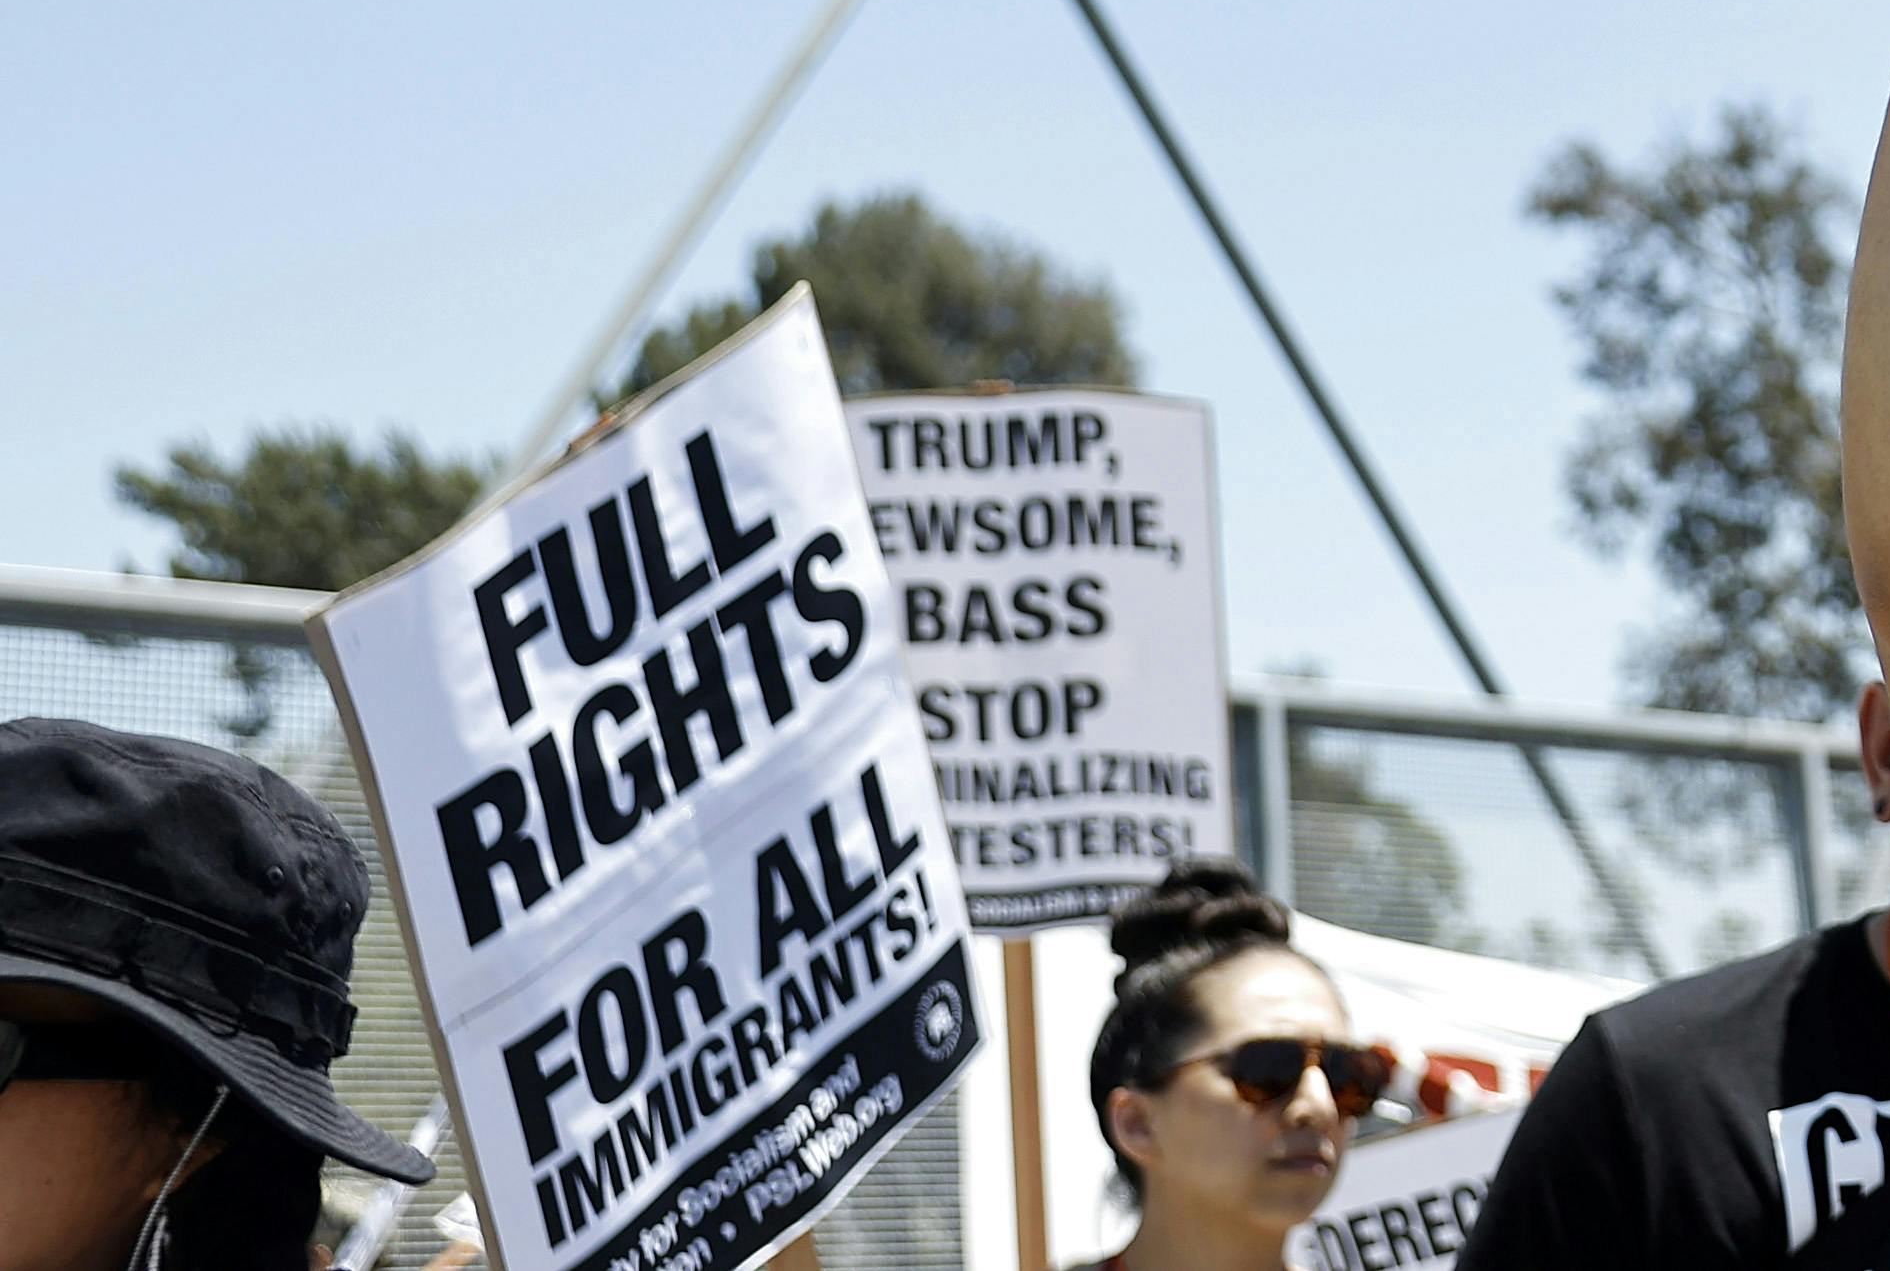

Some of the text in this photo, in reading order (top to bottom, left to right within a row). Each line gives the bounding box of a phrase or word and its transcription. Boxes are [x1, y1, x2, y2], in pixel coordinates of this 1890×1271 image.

[867, 411, 1120, 478] TRUMP,
[870, 494, 1183, 570] EWSOME,
[472, 429, 777, 728] FULL
[904, 575, 1108, 645] BASS
[436, 531, 865, 948] RIGHTS
[918, 678, 1103, 743] STOP
[935, 753, 1212, 803] INALIZING
[951, 815, 1194, 866] TESTERS!
[501, 763, 920, 1167] FOR ALL
[534, 869, 938, 1252] IMMIGRANTS!
[638, 1210, 679, 1267] for
[677, 1103, 816, 1228] Socialism
[808, 1053, 862, 1122] and
[1316, 1184, 1492, 1271] DEREC
